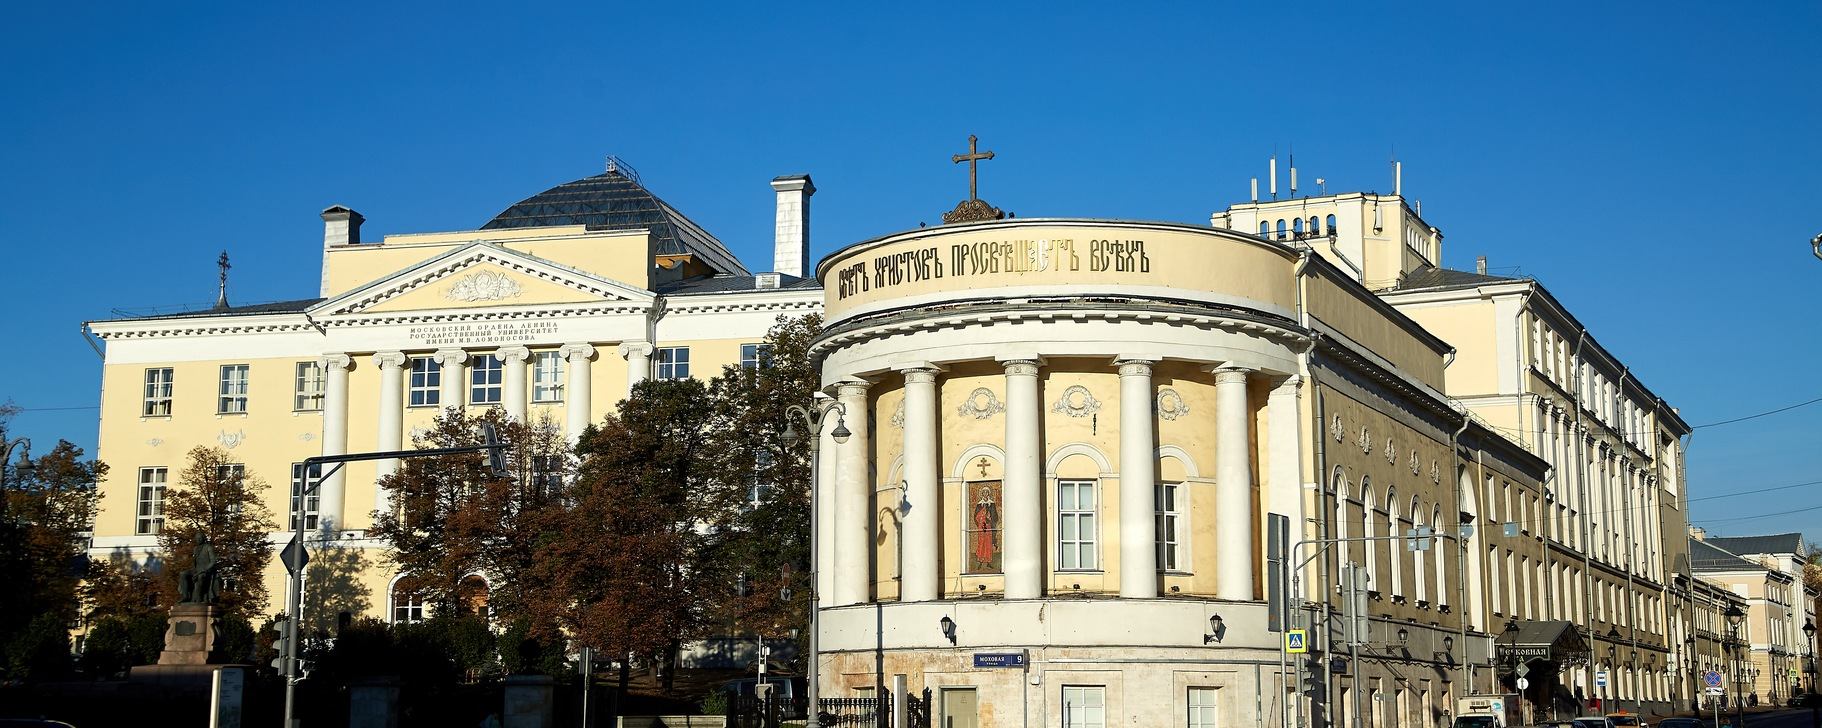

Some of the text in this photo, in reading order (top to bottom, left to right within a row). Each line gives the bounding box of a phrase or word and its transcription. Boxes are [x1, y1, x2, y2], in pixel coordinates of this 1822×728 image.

[410, 321, 558, 334] МОСКОВСКИЙ ОРДЕНА ЛЕНИНА
[410, 328, 559, 339] ГОСУДАРСТВЕННЫЙ УНИВЕРСИТЕТ
[475, 335, 536, 343] ЛОМОНОСОВА
[1017, 655, 1023, 663] 9
